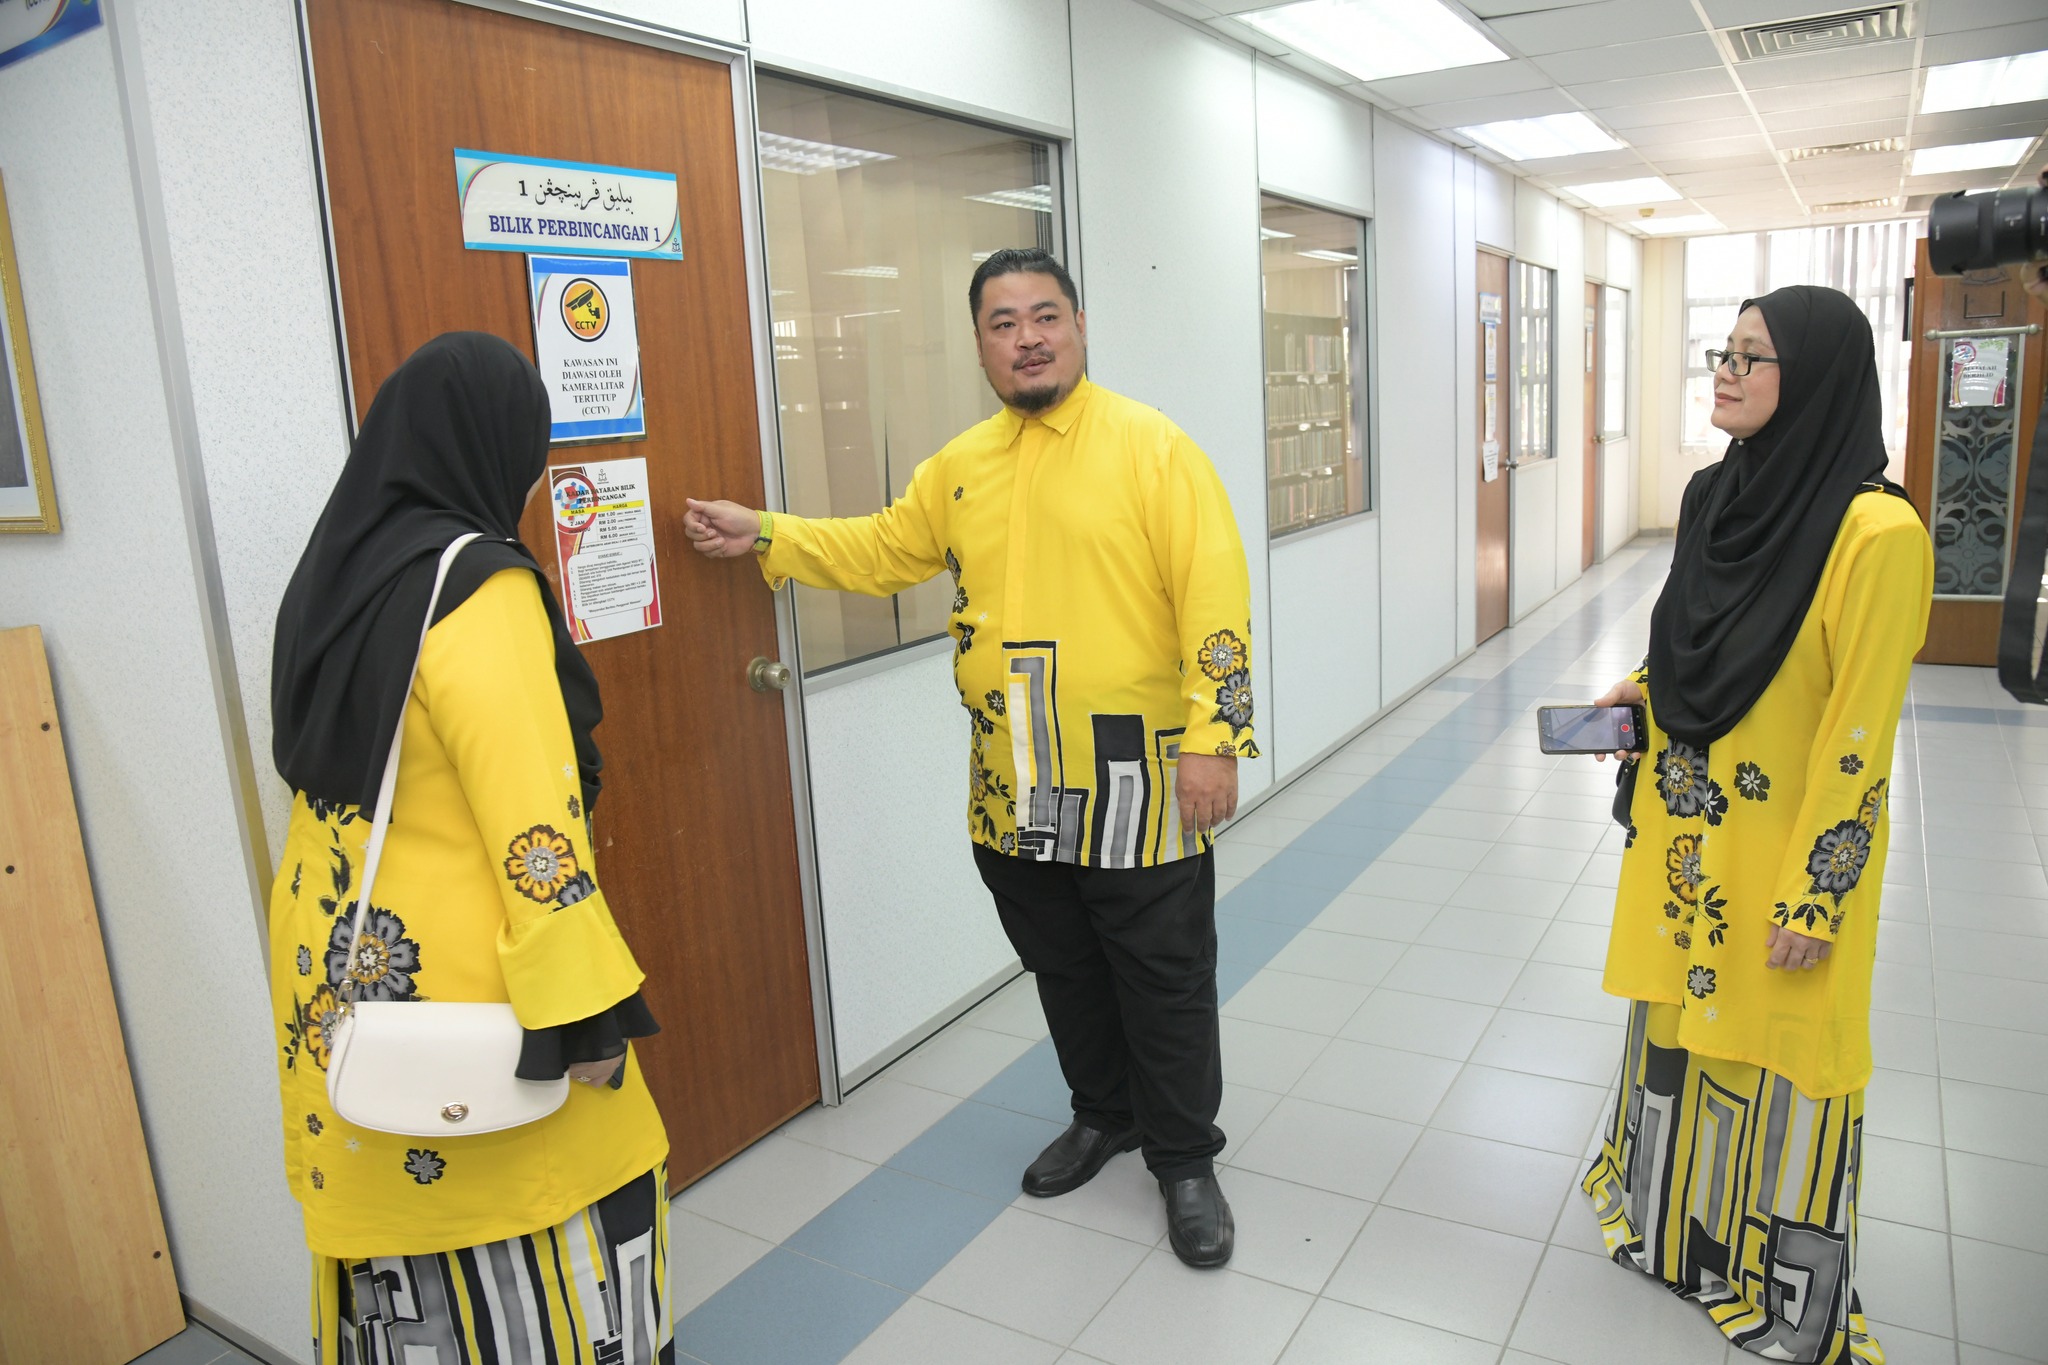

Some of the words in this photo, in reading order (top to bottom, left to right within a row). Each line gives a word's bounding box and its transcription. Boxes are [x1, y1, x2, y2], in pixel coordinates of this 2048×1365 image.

[518, 180, 528, 196] 1
[489, 215, 534, 234] BILIK
[538, 218, 649, 242] PERBINCANGAN
[654, 227, 661, 242] 1
[575, 321, 597, 330] CCTV
[564, 358, 604, 368] KAWASAN
[606, 358, 618, 366] INI
[562, 370, 597, 380] DIAWASI
[599, 370, 622, 378] OLEH
[562, 383, 599, 392] KAMERA
[600, 382, 624, 390] LITAR
[573, 394, 617, 403] TERTUTUP
[582, 406, 610, 416] (CCTV)
[566, 488, 590, 497] KADAR
